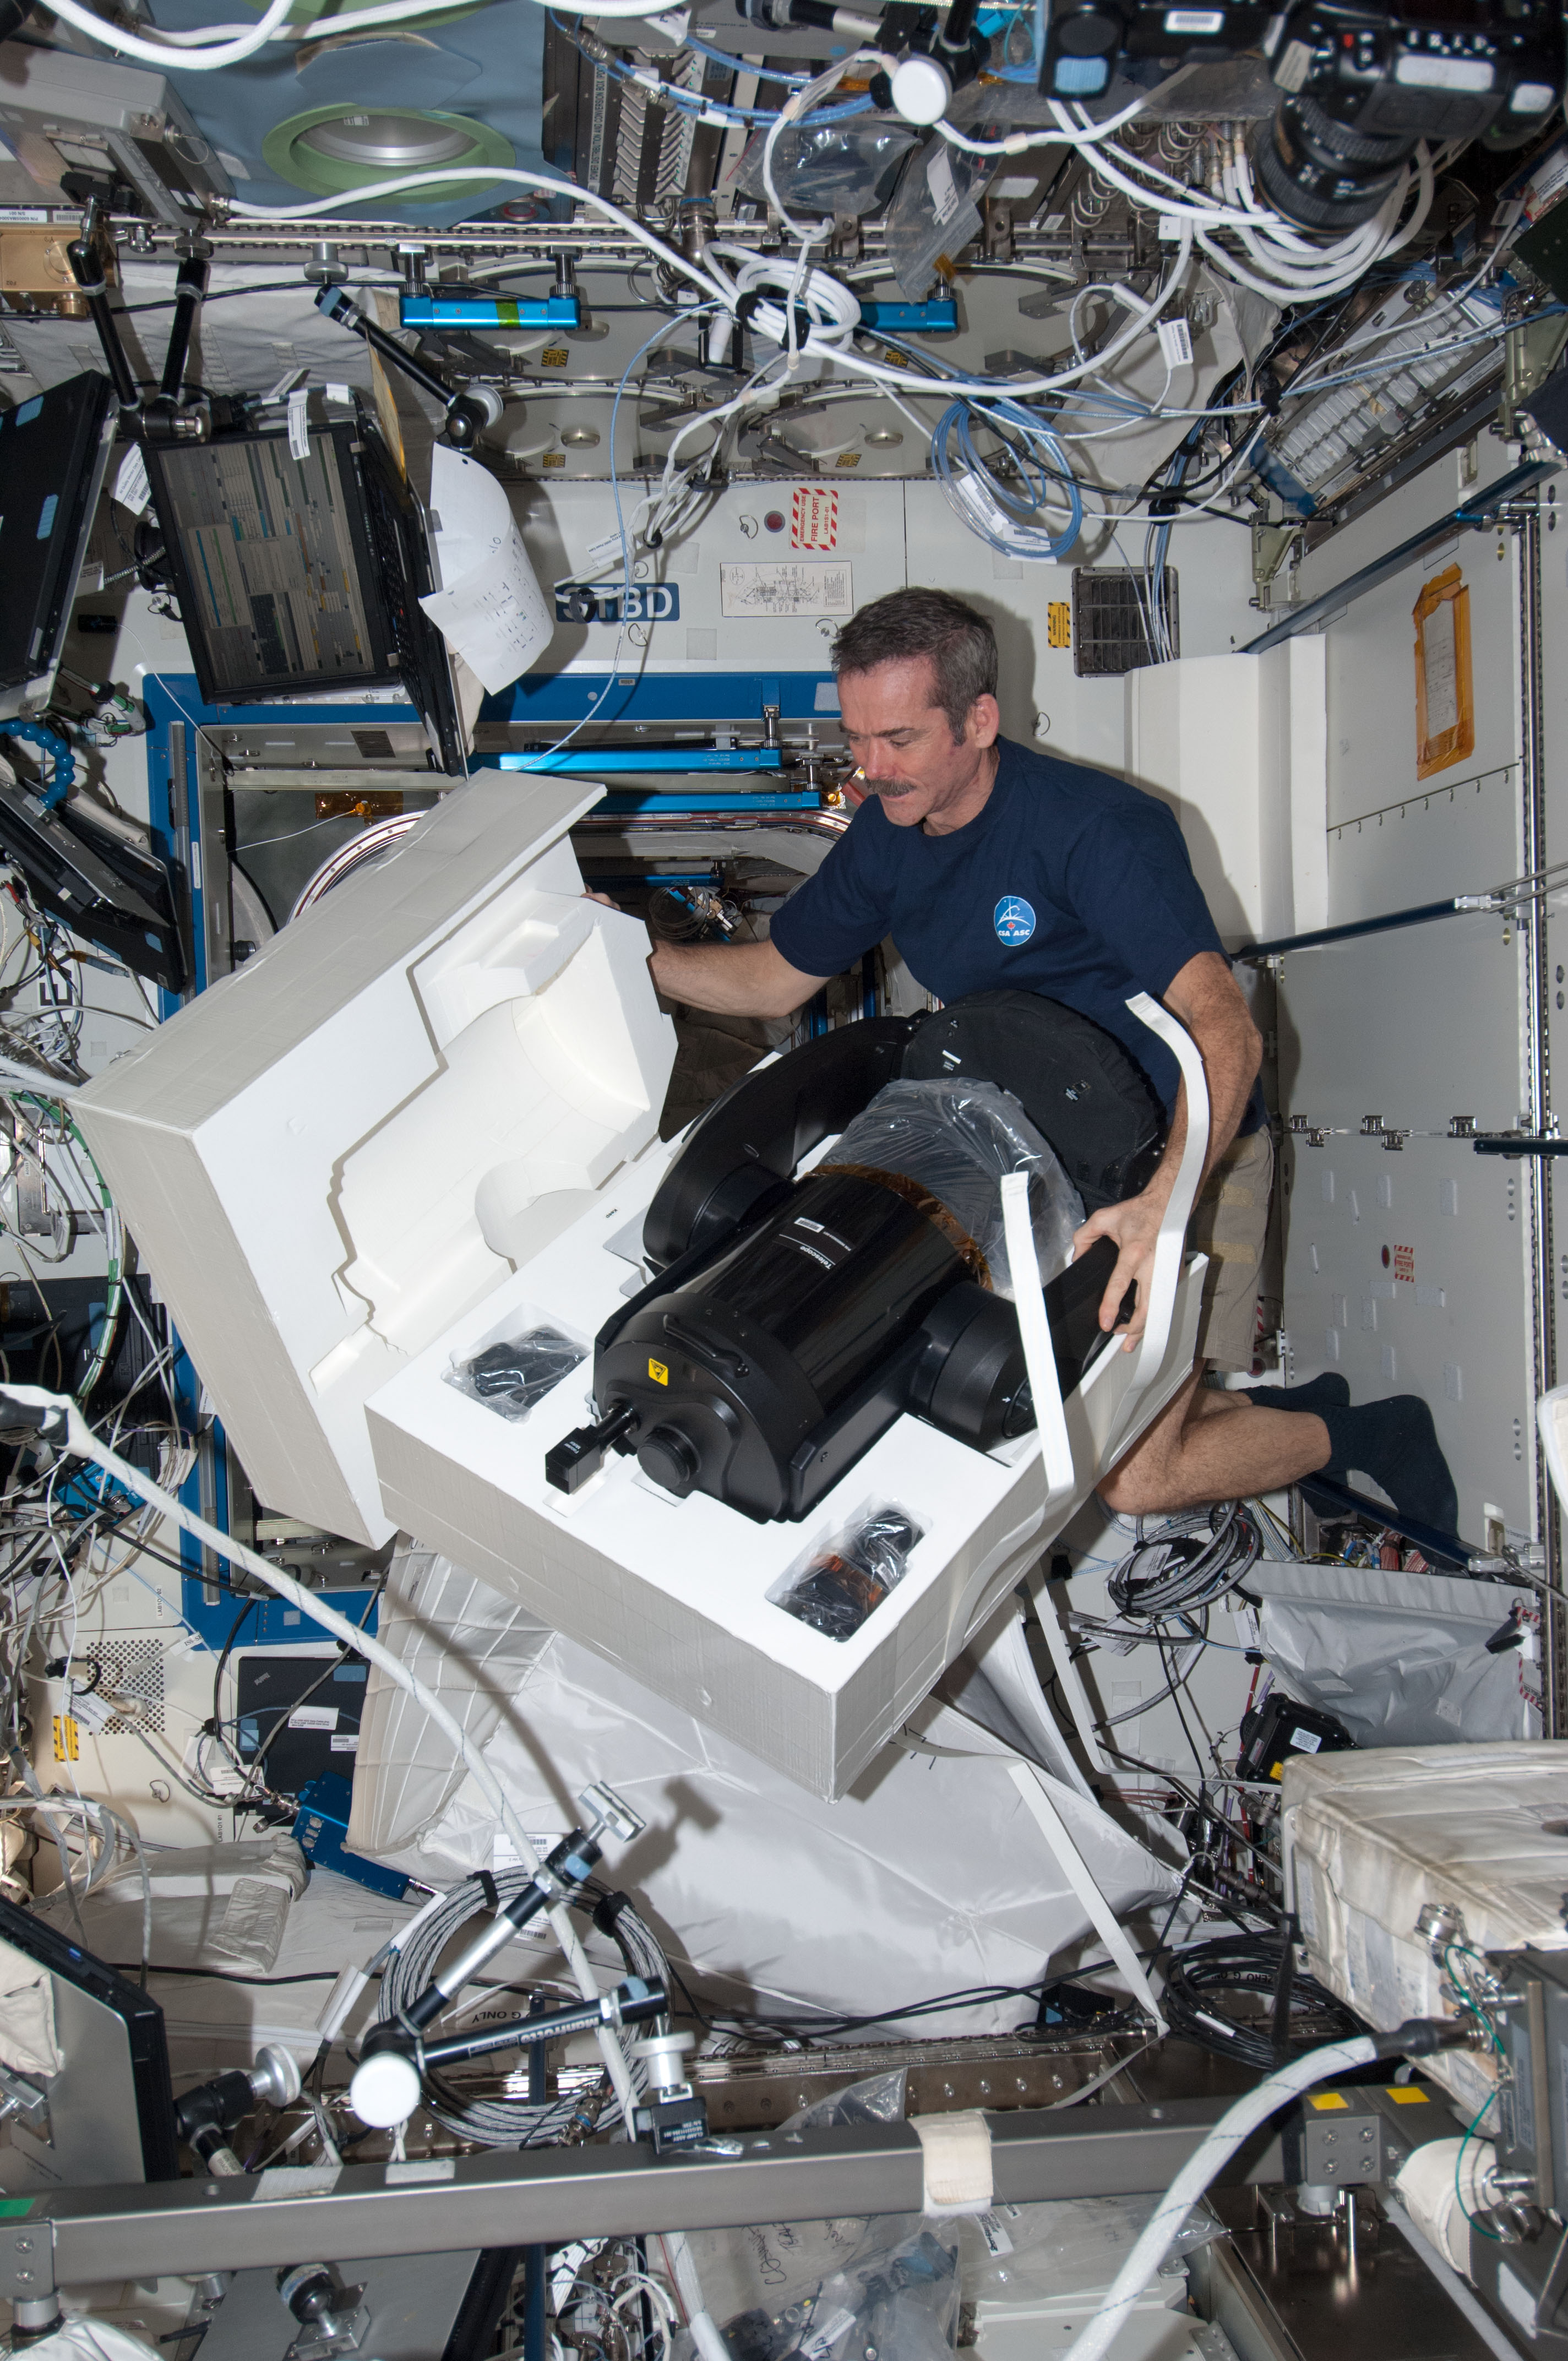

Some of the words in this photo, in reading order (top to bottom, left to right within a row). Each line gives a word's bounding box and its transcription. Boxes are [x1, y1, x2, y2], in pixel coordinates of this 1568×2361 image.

[595, 80, 605, 90] BOX
[594, 91, 604, 122] CONVERSION
[812, 496, 820, 520] PORT
[562, 586, 673, 619] STBD
[606, 1209, 618, 1218] Keep
[799, 1245, 832, 1269] Telescope
[1233, 1971, 1242, 1980] G
[471, 2011, 507, 2024] ONLY
[511, 2011, 522, 2020] G
[687, 2131, 703, 2140] CLAMP
